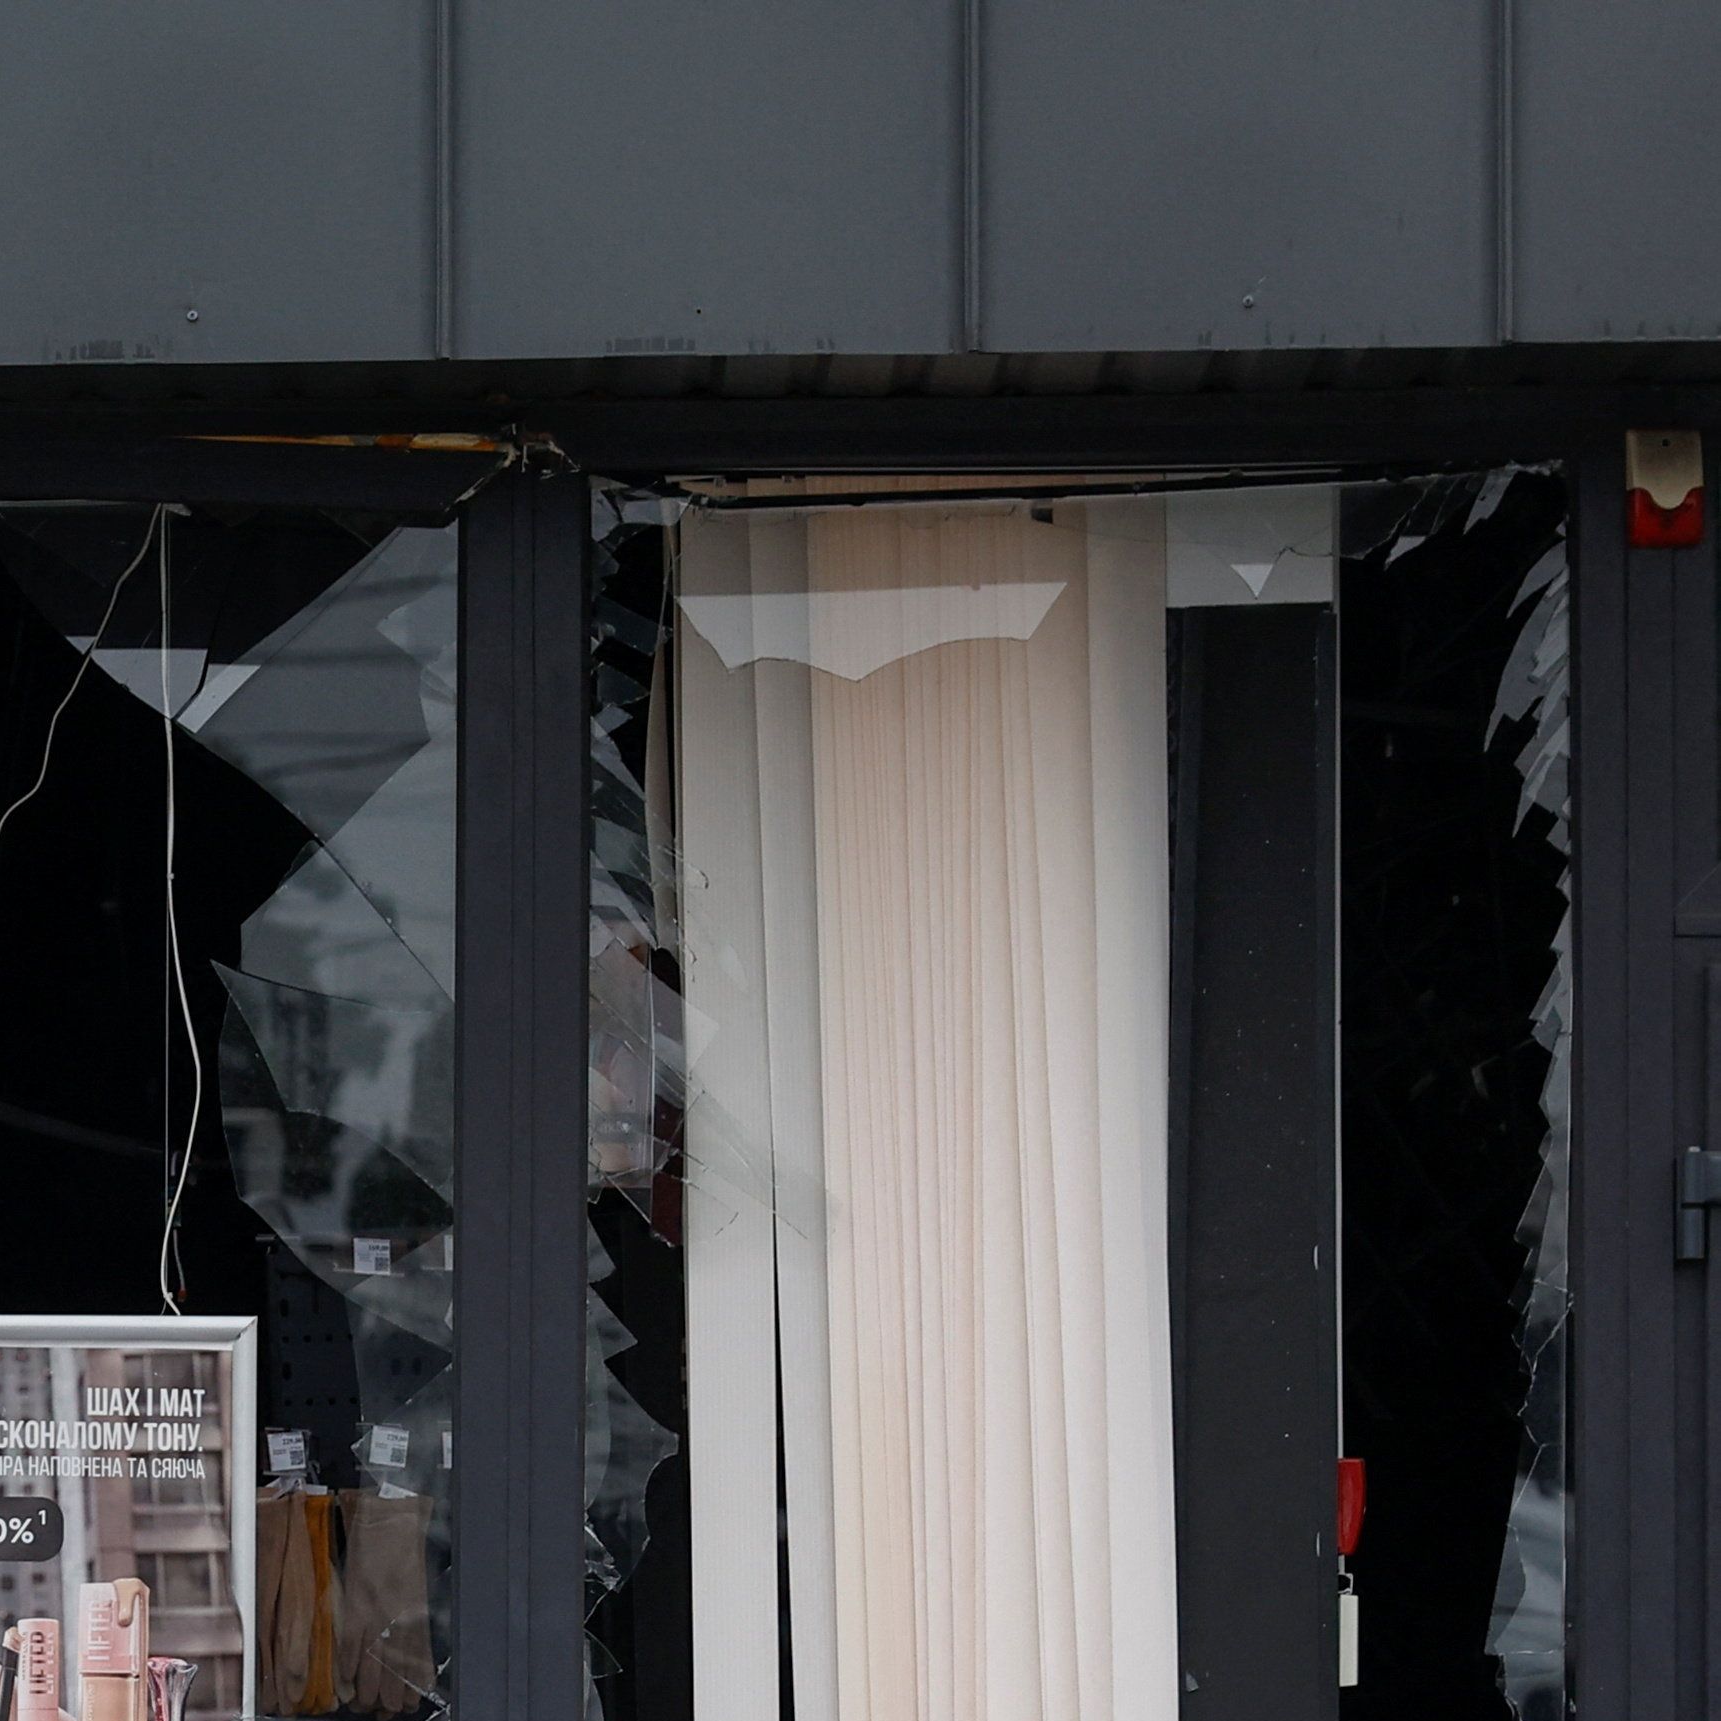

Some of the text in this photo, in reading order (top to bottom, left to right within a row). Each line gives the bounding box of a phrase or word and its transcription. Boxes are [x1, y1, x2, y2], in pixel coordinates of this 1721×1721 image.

[87, 1387, 140, 1417] ШАХ
[159, 1388, 206, 1418] МАТ
[143, 1422, 204, 1452] ТОНУ.
[28, 1457, 123, 1477] НАПОВНЕНА
[127, 1458, 147, 1478] ТА
[151, 1458, 206, 1479] СЯЮЧА
